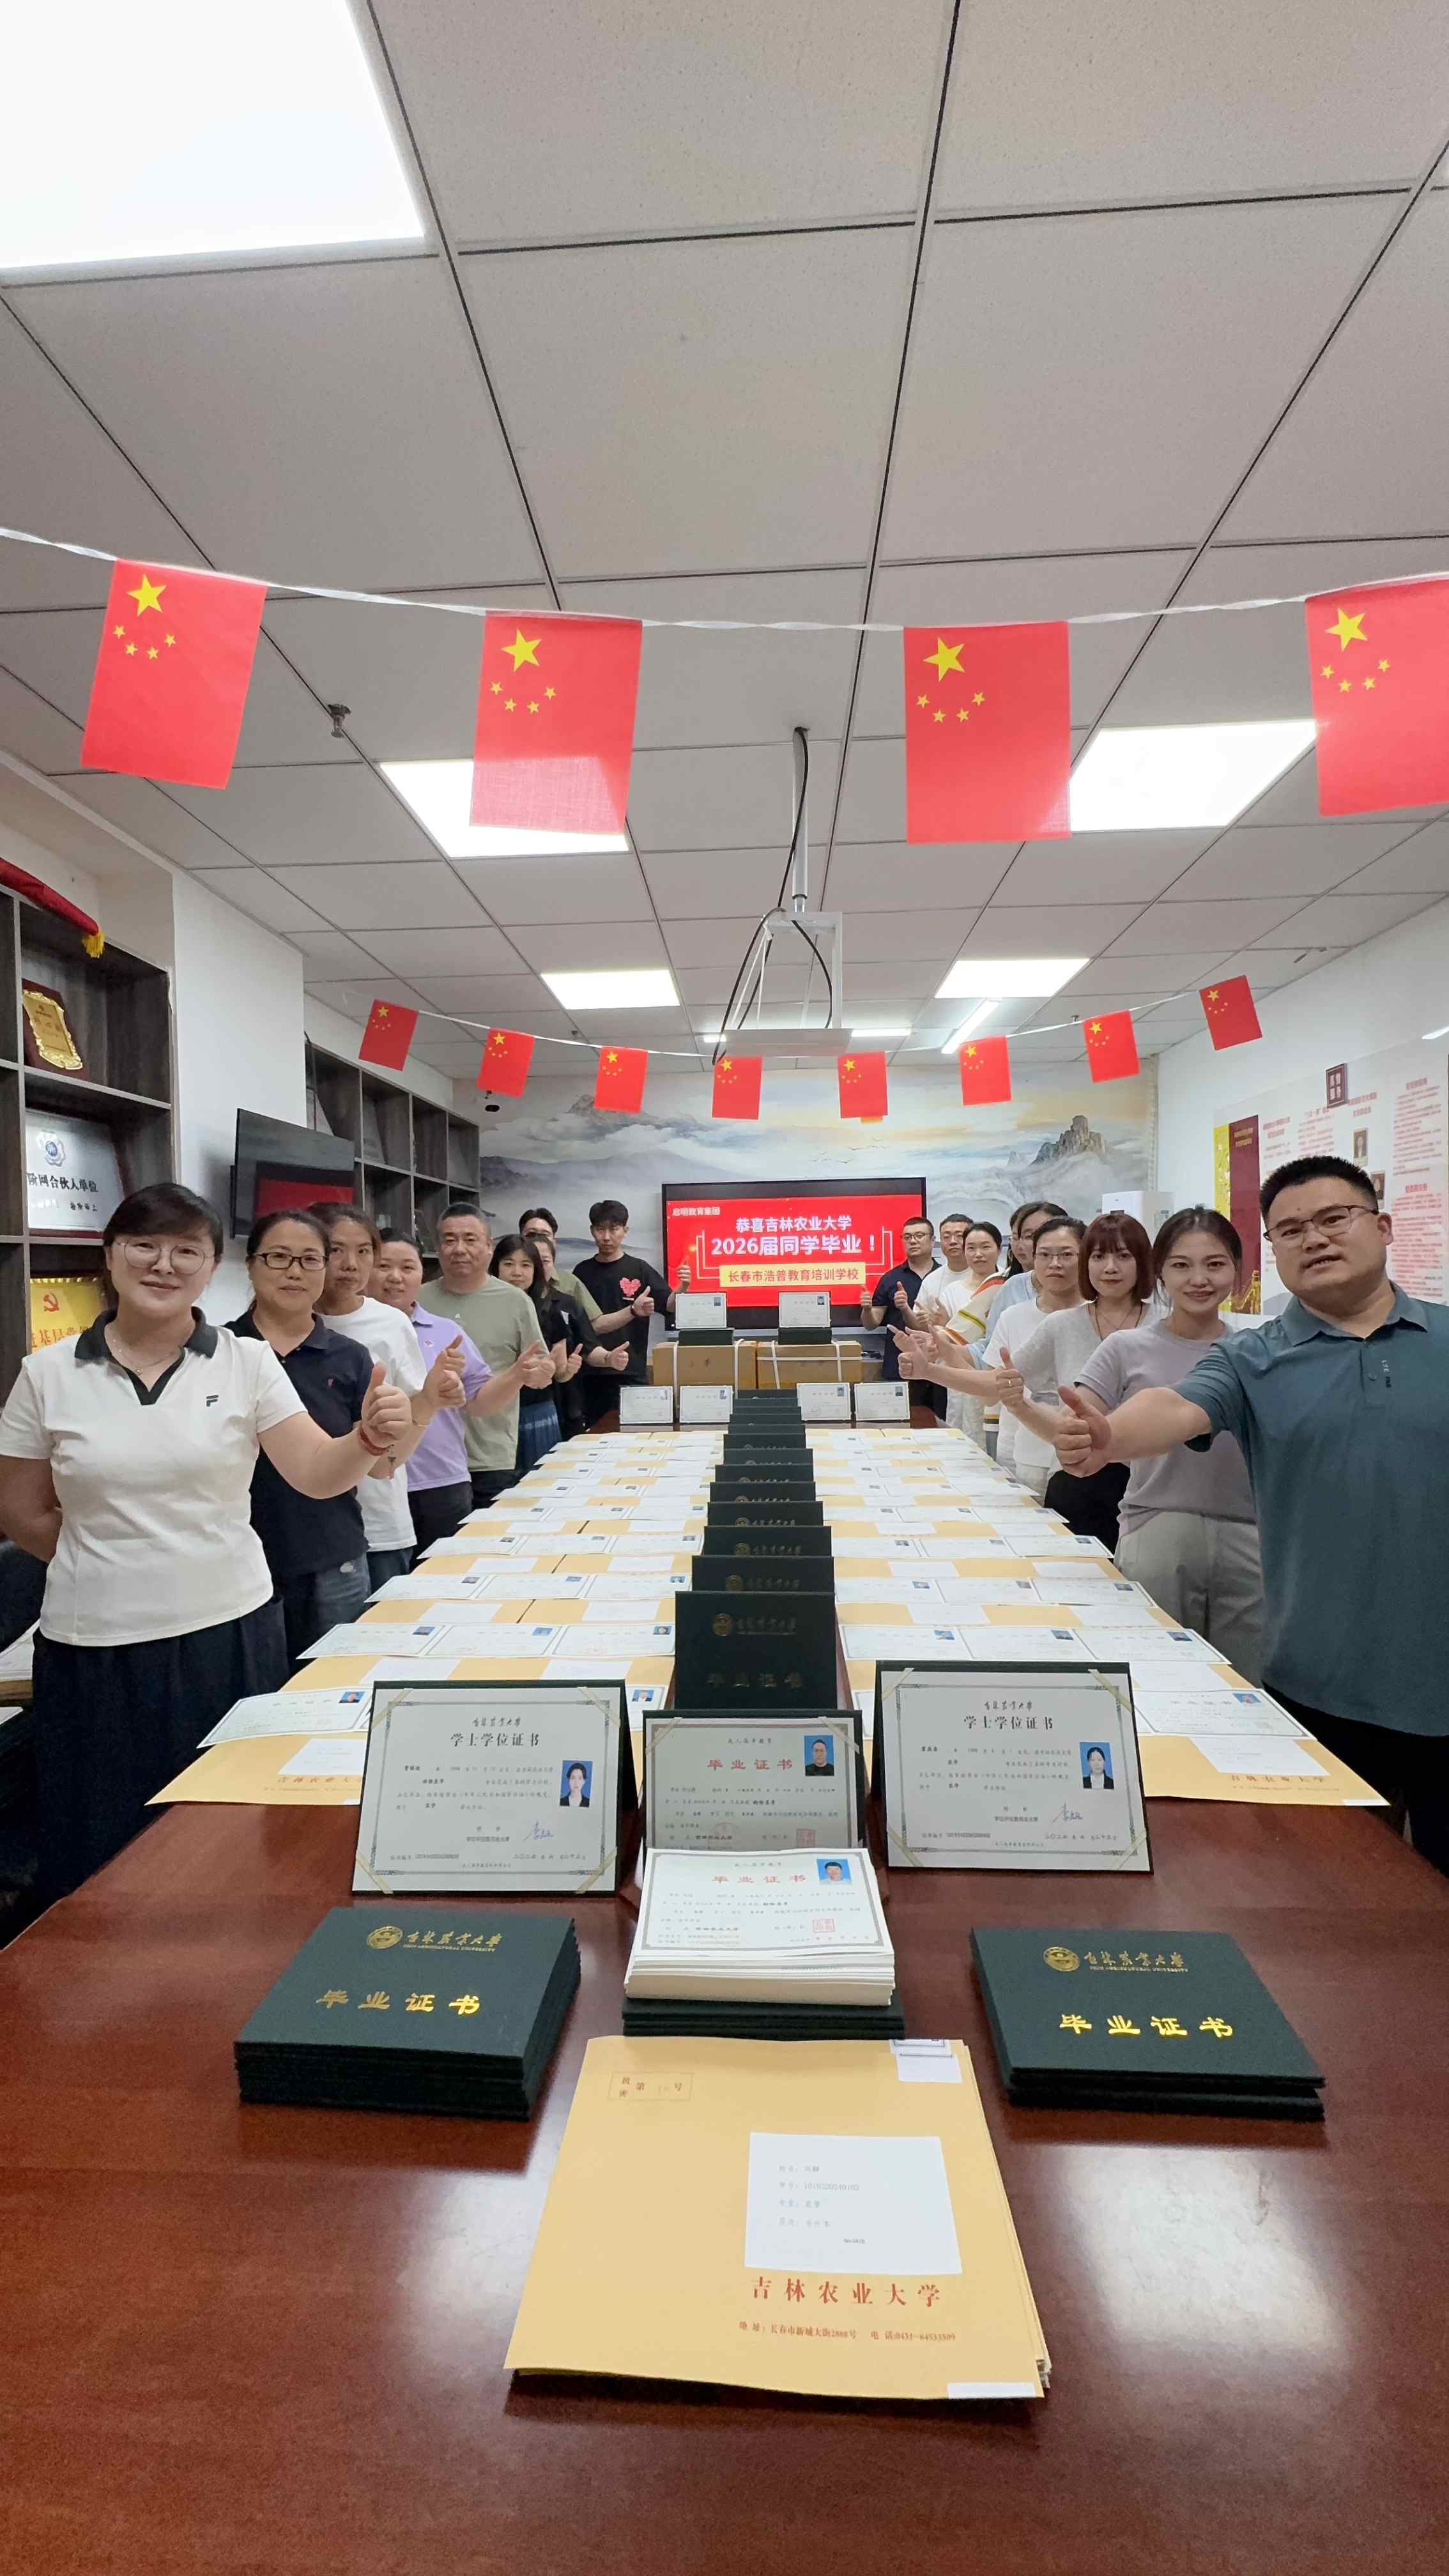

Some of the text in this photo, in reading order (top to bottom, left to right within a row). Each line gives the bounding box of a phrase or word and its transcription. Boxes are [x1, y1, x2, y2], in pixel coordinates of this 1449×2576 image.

[736, 1215, 852, 1233] 恭喜吉林农业大学
[711, 1234, 875, 1255] 2026届同学毕业！
[728, 1268, 859, 1283] 长春市浩普教育培训学校
[963, 1715, 1054, 1729] 学士学位证书
[450, 1733, 539, 1747] 学士学位证书
[707, 1759, 793, 1770] 毕业证书
[712, 1874, 807, 1883] 毕业证书
[316, 1990, 480, 2015] 毕业证书
[1059, 2014, 1234, 2037] 毕业证书
[751, 2276, 941, 2307] 吉林农业大学
